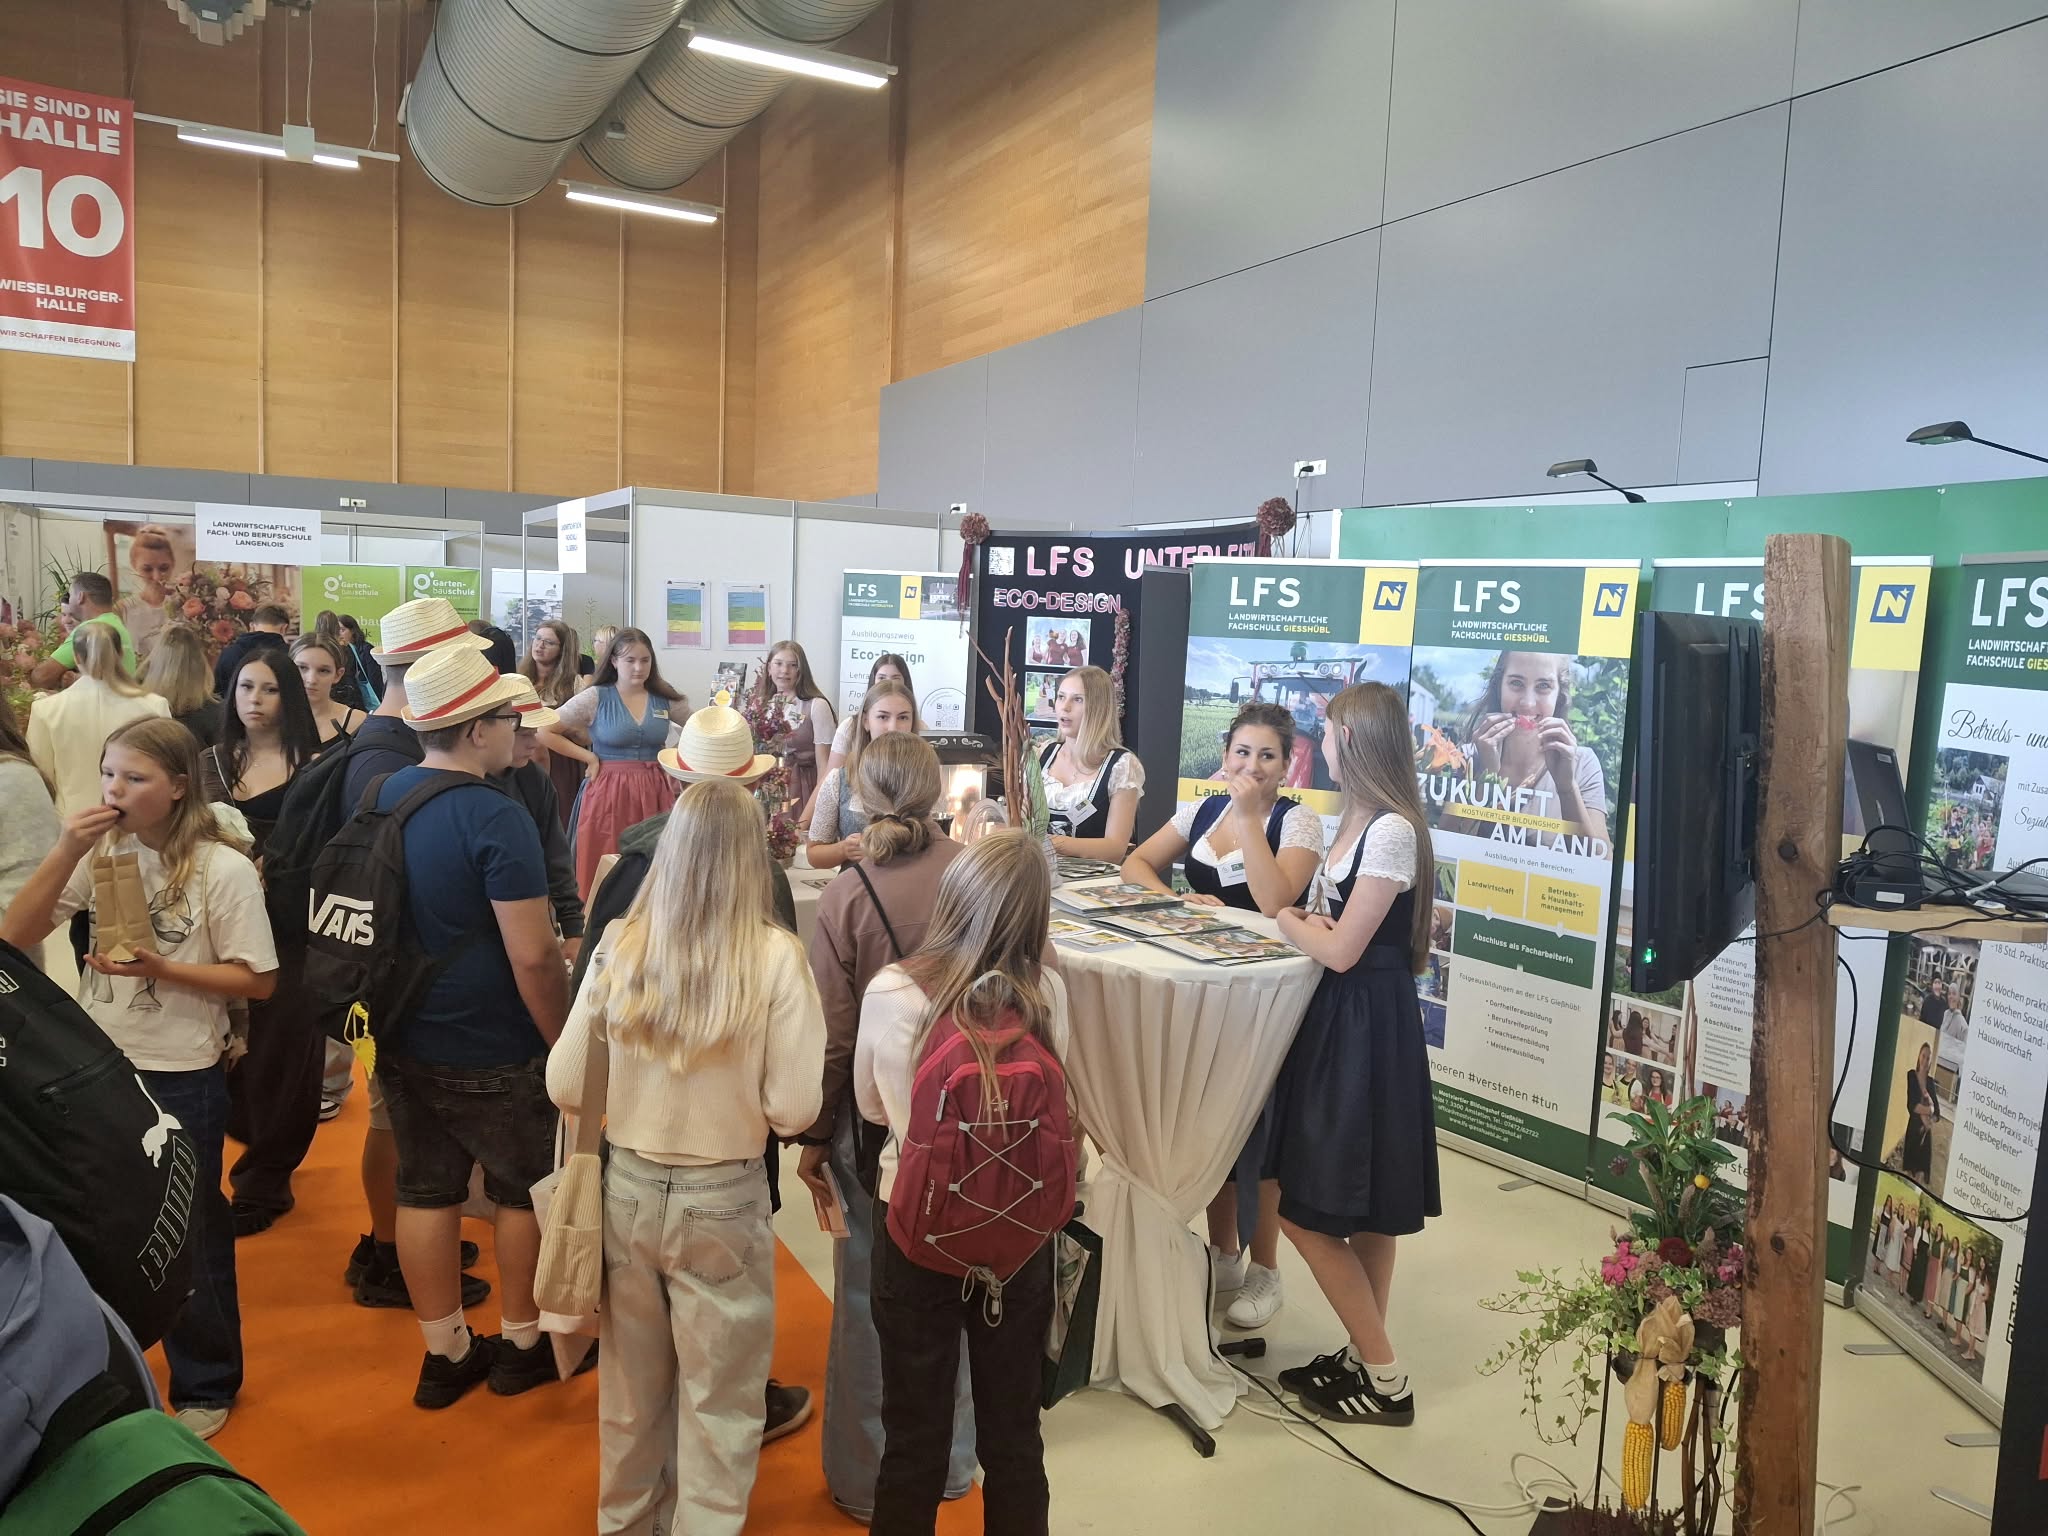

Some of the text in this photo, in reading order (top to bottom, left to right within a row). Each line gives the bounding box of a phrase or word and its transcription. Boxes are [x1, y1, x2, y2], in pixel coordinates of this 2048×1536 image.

[33, 95, 91, 119] SIND
[97, 107, 120, 125] IN
[0, 111, 120, 155] HALLE
[0, 166, 125, 257] 10
[0, 279, 124, 303] WIESELBURGER-
[36, 297, 86, 313] HALLE
[19, 331, 66, 342] SCHAFFEN
[67, 336, 121, 348] BEGEGNUNG
[206, 529, 231, 537] FACH-
[251, 532, 312, 541] BERUFSSCHULE
[212, 521, 307, 532] LANDWIRTSCHAFTLICHE
[235, 539, 285, 548] LANGENLOIS
[1026, 545, 1095, 578] LFS
[341, 581, 371, 589] Garten-
[432, 579, 467, 588] Garten-
[432, 587, 476, 596] bauschule
[848, 583, 878, 598] LFS
[1229, 576, 1301, 608] LFS
[993, 587, 1122, 614] ECO-DESIGN
[1453, 580, 1521, 614] LFS
[1694, 582, 1765, 621] LFS
[1971, 576, 2048, 628] LFS
[1228, 612, 1329, 624] LANDWIRTSCHAFTLICHE
[1228, 622, 1331, 634] FACHSCHULE GIESSHÜBL
[1452, 620, 1548, 632] LANDWIRTSCHAFTLICHE
[851, 630, 915, 641] Ausbildungszweig
[1451, 630, 1550, 644] FACHSCHULE GIESSHÜBL
[851, 647, 925, 665] Eco-ign
[1966, 654, 2026, 669] FACHSCHULE
[1947, 709, 2021, 744] Betriebs-
[1416, 772, 1554, 818] ZUKUNFT
[2017, 781, 2030, 793] mit
[1511, 815, 1561, 830] BILDUNGSHOF
[1490, 822, 1608, 860] AM LAND
[1484, 850, 1518, 866] Ausbildung
[1527, 859, 1540, 868] den
[1540, 861, 1576, 875] Bereichen:
[1467, 880, 1515, 896] Landwirtschaft
[1548, 886, 1580, 899] Betriebs-
[1540, 902, 1584, 917] management
[1541, 893, 1585, 908] & Haushalts-
[308, 887, 375, 946] VANS
[1472, 932, 1508, 948] Abschluss
[1508, 941, 1520, 952] als
[2003, 945, 2018, 959] Std.
[1459, 972, 1514, 995] Folgeausbildungen
[1515, 988, 1524, 996] an
[1524, 989, 1536, 999] der
[1537, 993, 1549, 1003] LFS
[1712, 973, 1750, 988] Textildesign
[1710, 992, 1746, 1006] Gesundheit
[1984, 981, 1994, 991] 22
[1995, 982, 2025, 1003] Wochen
[1709, 1001, 1732, 1013] Soziale
[1992, 999, 2022, 1020] Wochen
[1491, 1013, 1549, 1037] Berufsreifeprüfung
[1703, 1016, 1744, 1033] Abschlüsse:
[1993, 1017, 2023, 1038] Wochen
[2023, 1030, 2046, 1047] Land-
[1488, 1026, 1550, 1051] Erwachsenenbildung
[1977, 1028, 2032, 1061] Hauswirtschaft
[1490, 1040, 1545, 1065] Meisterausbildung
[1468, 1072, 1528, 1102] #verstehen
[1531, 1093, 1559, 1112] #tun
[1970, 1070, 2009, 1098] Zusätzlich:
[1986, 1096, 2017, 1120] Stunden
[1974, 1108, 1999, 1129] Woche
[1999, 1121, 2022, 1141] Praxis
[2022, 1135, 2034, 1148] als
[1956, 1169, 1968, 1183] LFS
[1958, 1152, 2023, 1197] Anmeldung unter:
[1953, 1186, 1970, 1201] oder
[137, 1135, 197, 1292] PUMA
